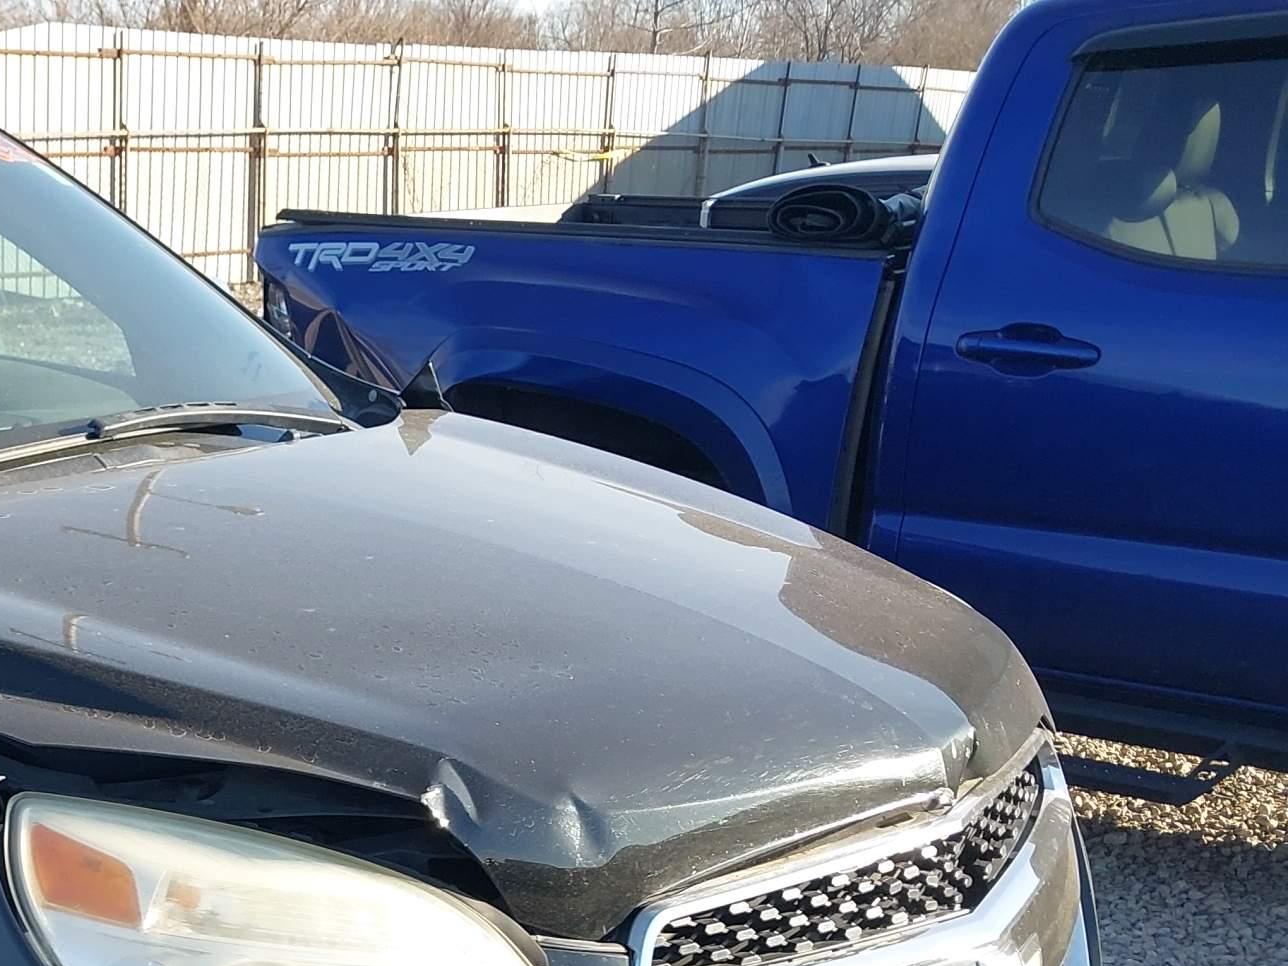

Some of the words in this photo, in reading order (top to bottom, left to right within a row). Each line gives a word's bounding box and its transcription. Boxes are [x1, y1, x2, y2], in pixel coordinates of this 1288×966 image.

[288, 241, 380, 272] TRD
[376, 241, 476, 264] 4X4
[368, 260, 463, 272] SPORT
